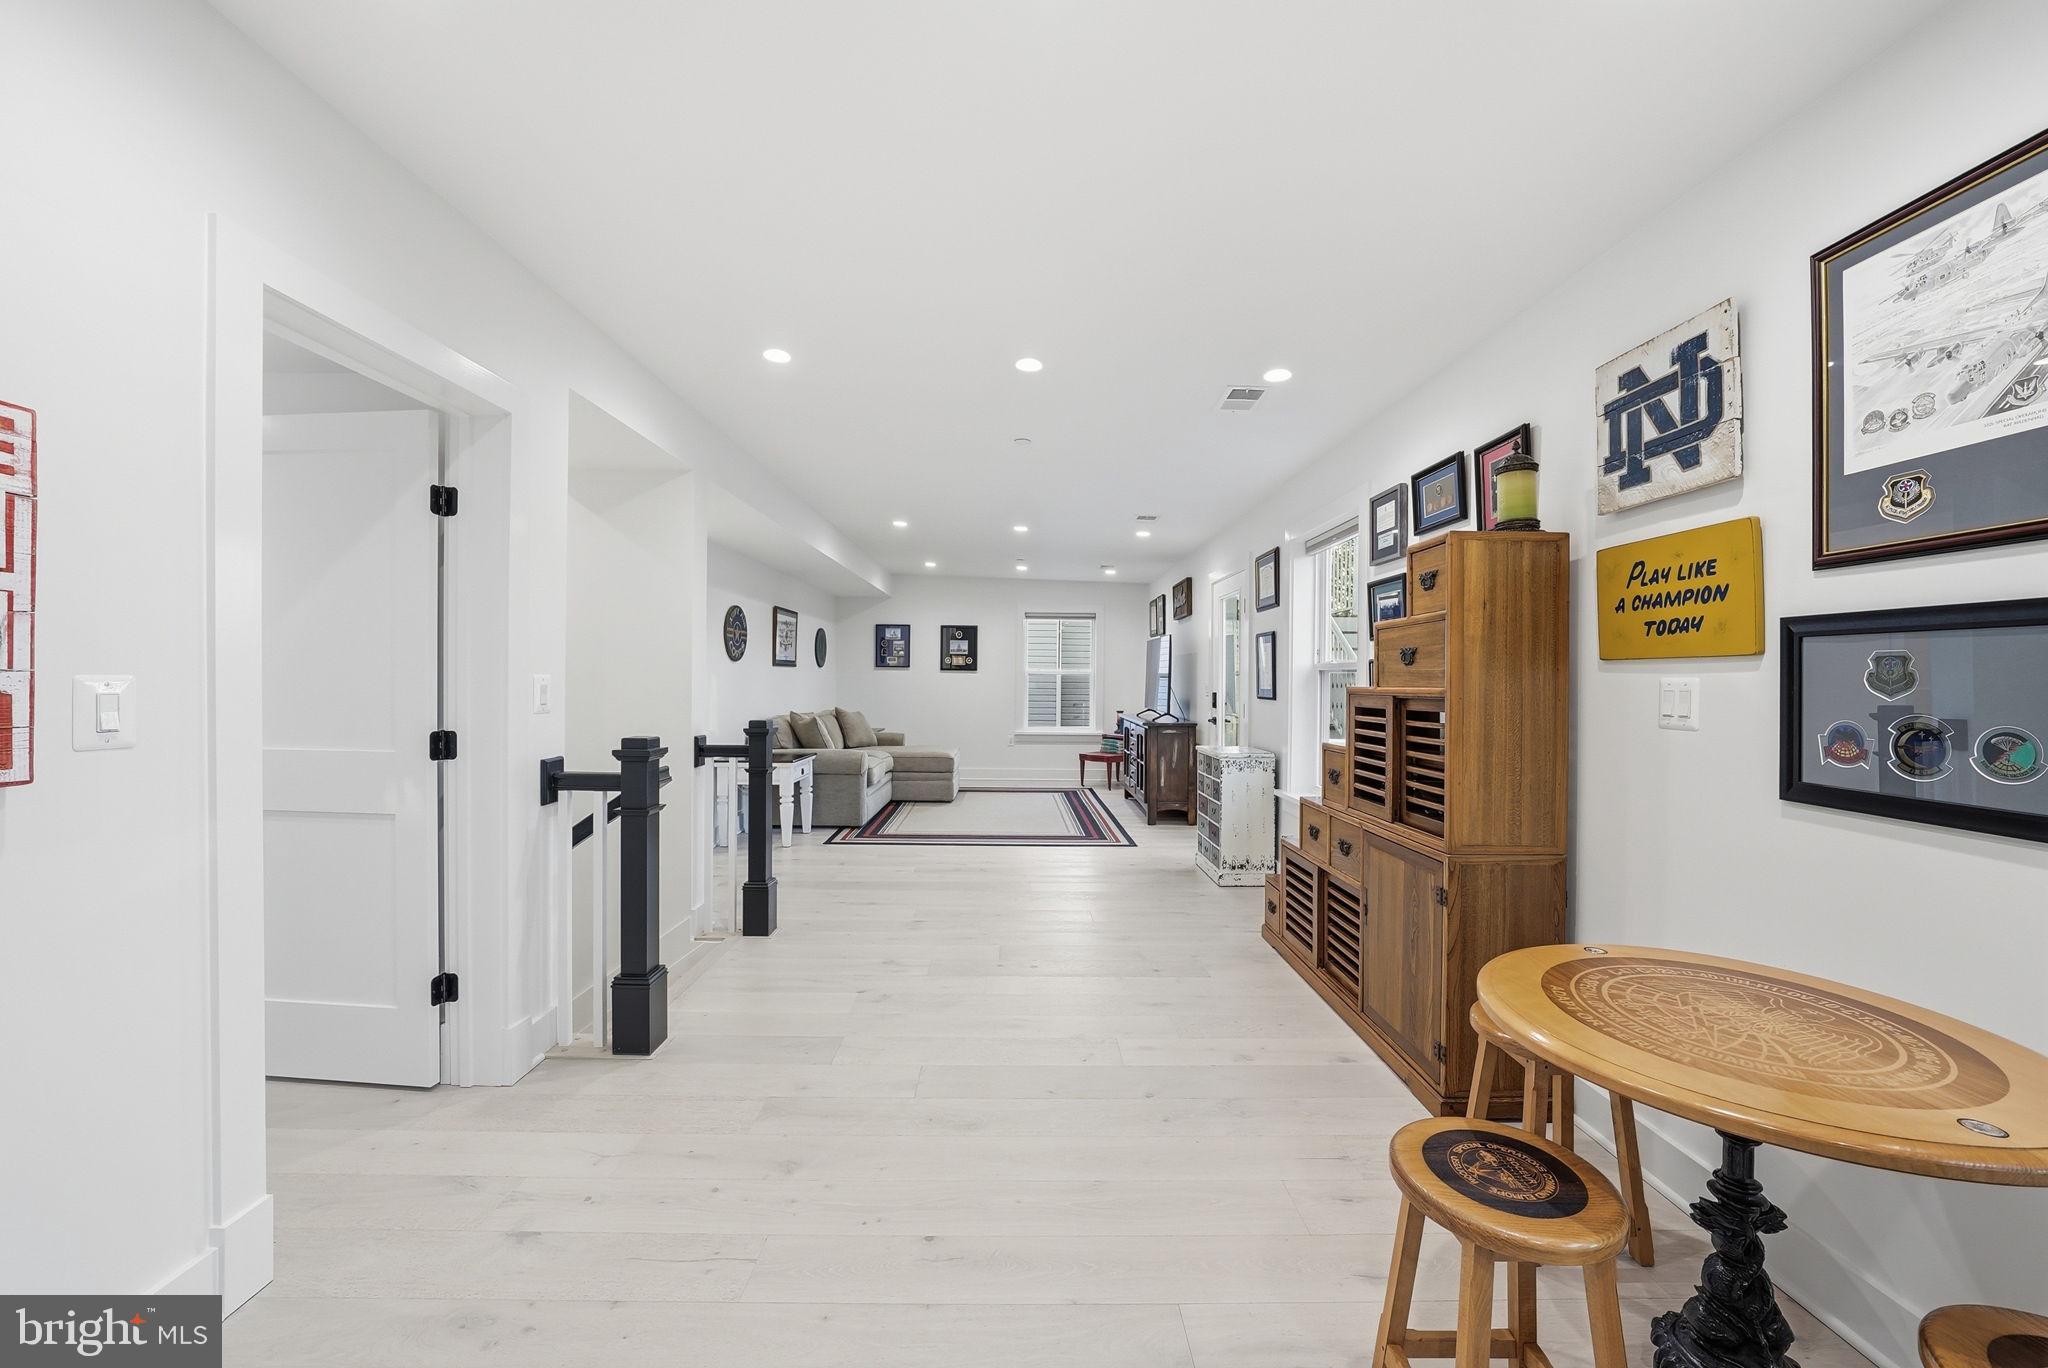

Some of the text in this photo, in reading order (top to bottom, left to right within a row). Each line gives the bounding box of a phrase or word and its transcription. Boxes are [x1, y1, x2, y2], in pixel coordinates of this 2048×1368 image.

[1626, 558, 1718, 589] PLAY LIKE
[1614, 583, 1730, 614] A CHAMPION
[1643, 615, 1705, 637] TODAY
[1549, 984, 1577, 1013] ADAPT
[1578, 1010, 1601, 1028] OR
[1602, 1026, 1692, 1063] PERISH
[1486, 1143, 1547, 1173] OPERATIONS
